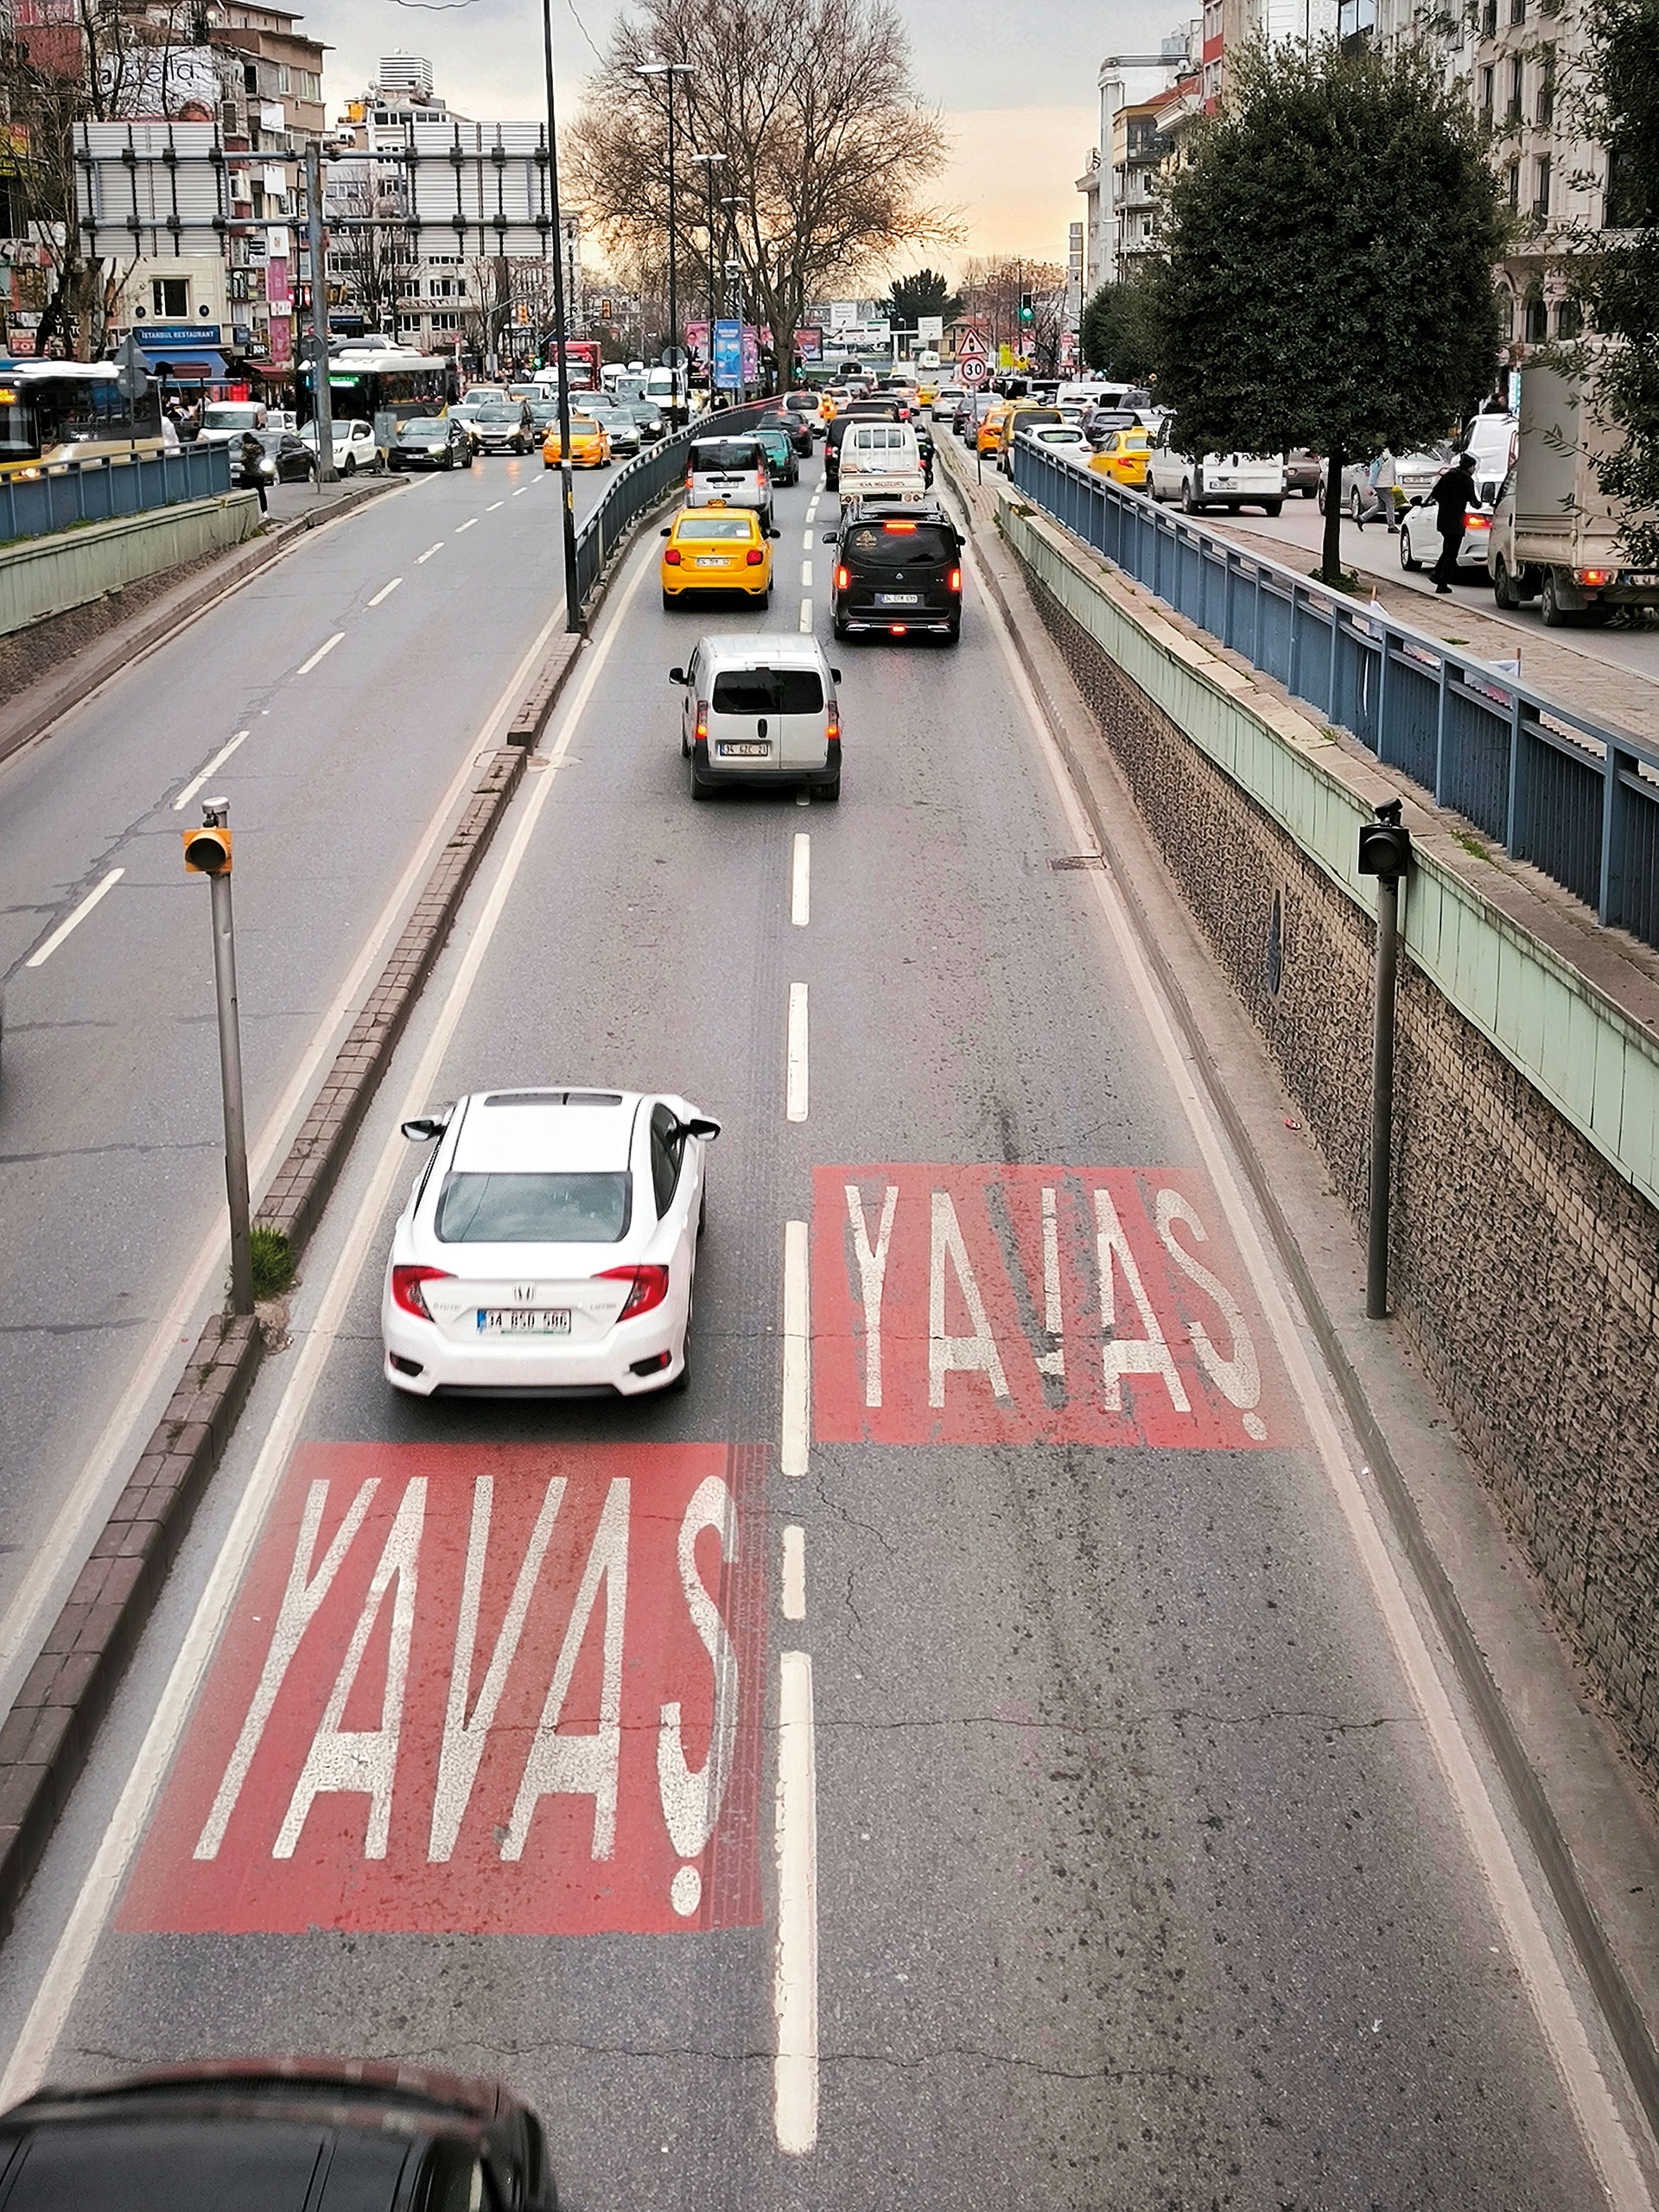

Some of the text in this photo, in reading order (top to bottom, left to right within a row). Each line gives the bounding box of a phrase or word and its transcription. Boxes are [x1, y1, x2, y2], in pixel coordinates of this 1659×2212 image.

[173, 330, 214, 339] RESTAURANT
[967, 363, 982, 377] 30
[192, 1475, 740, 1917] YAVAŞ
